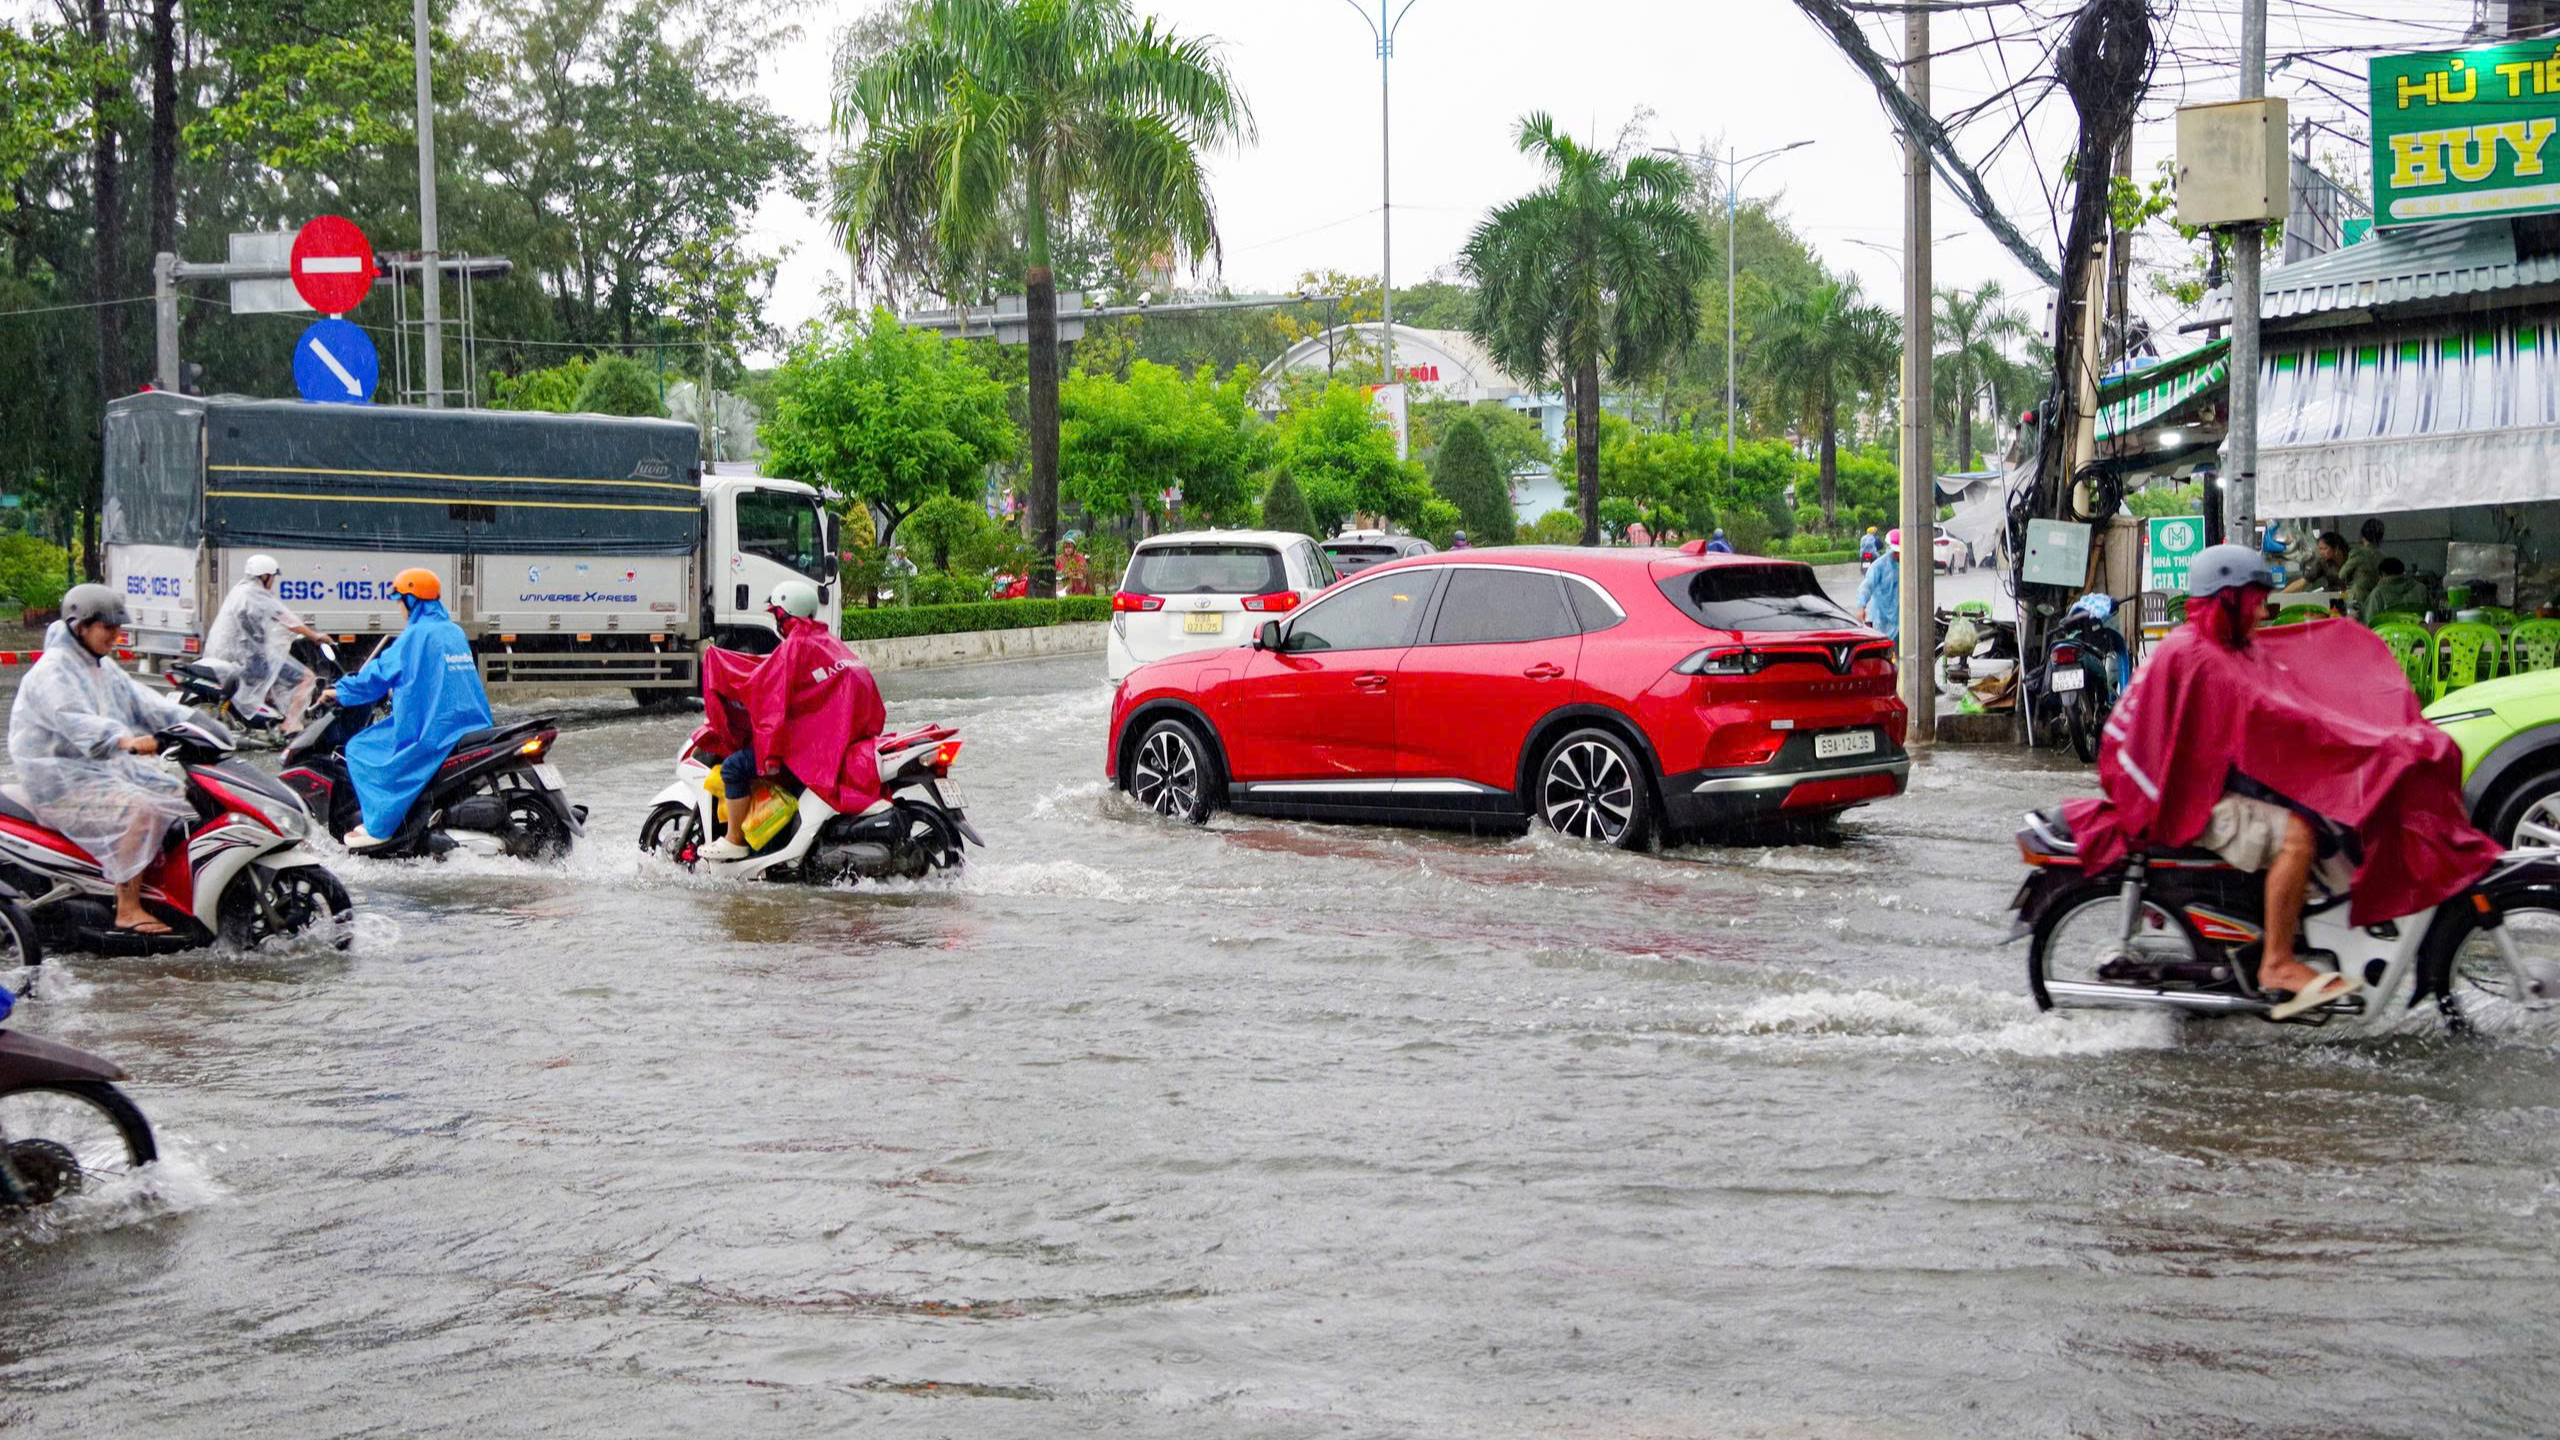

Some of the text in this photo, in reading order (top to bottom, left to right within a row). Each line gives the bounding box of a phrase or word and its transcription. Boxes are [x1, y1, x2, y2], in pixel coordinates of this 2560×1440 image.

[2397, 58, 2477, 110] HỦ
[2389, 117, 2557, 189] HUY
[2173, 555, 2193, 567] THU
[127, 575, 180, 598] 69C-105.13
[2153, 573, 2175, 590] GIA
[520, 594, 581, 602] UNIVERSE
